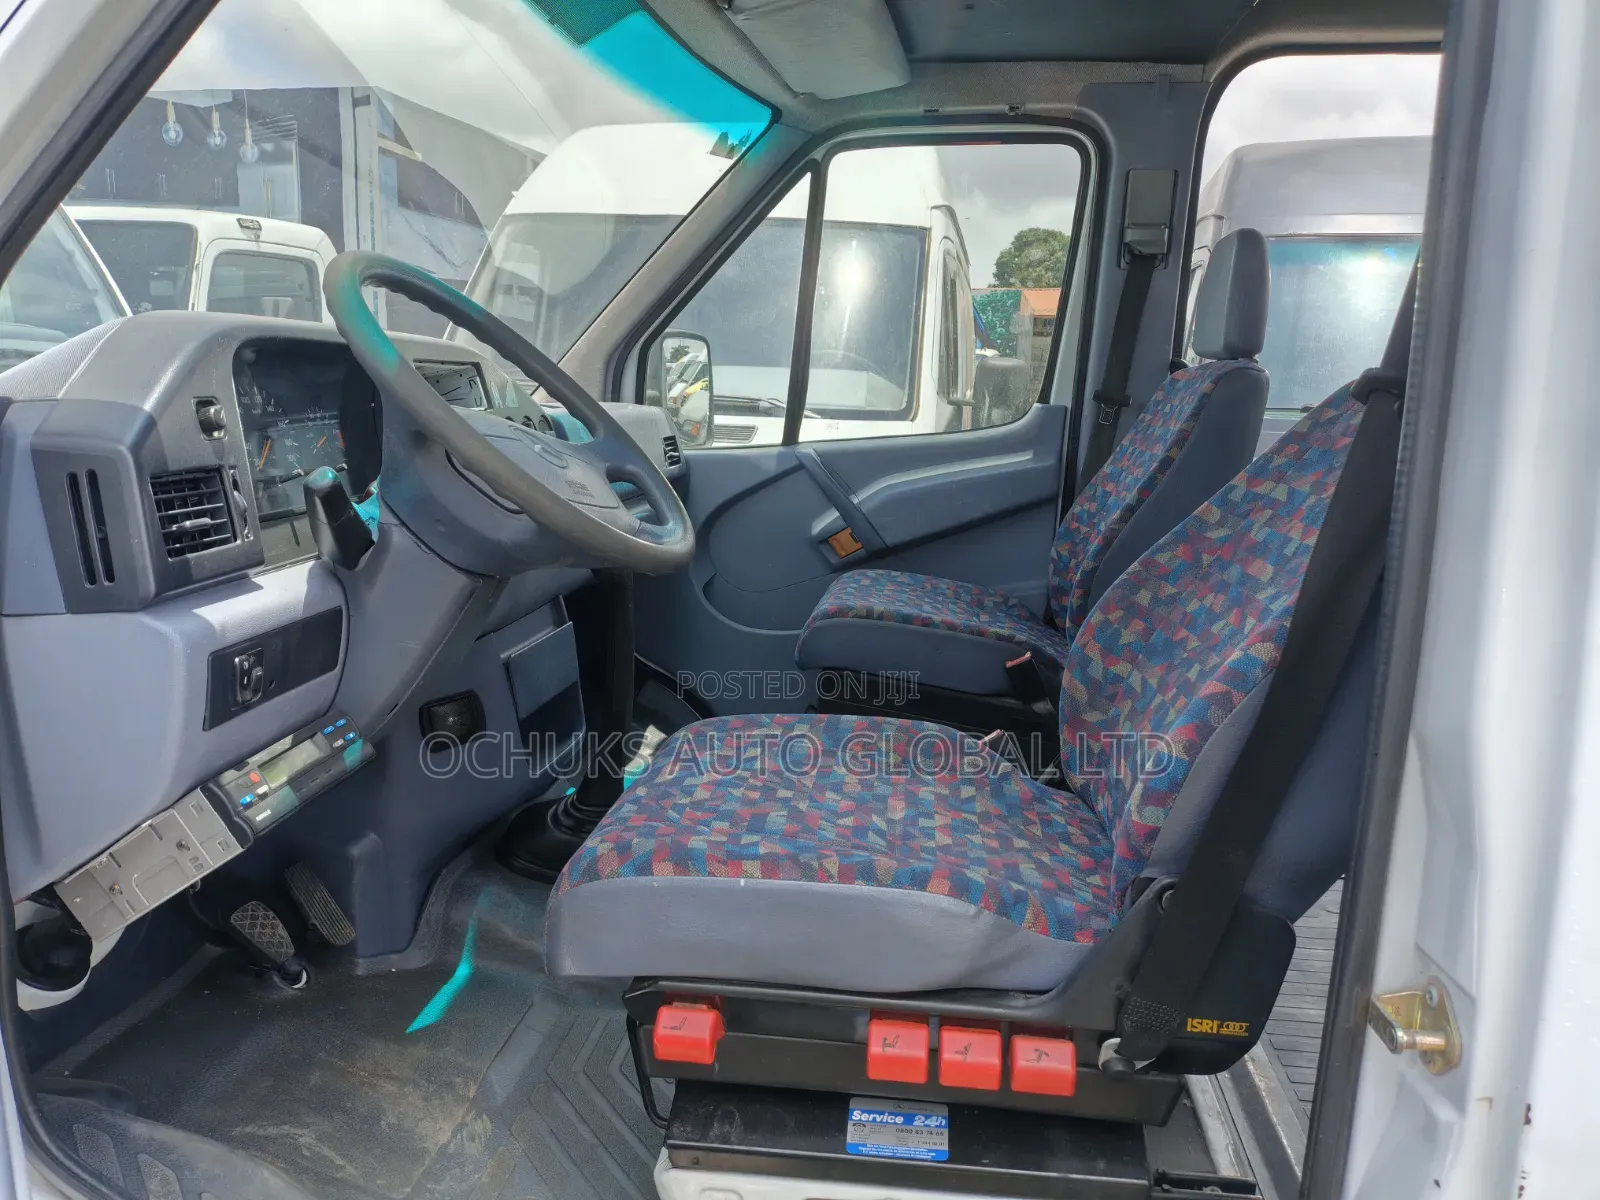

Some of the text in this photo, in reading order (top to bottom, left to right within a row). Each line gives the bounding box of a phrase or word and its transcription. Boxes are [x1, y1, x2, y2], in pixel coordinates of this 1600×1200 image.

[1186, 1017, 1219, 1034] ISRI
[852, 1110, 946, 1127] Service 24h
